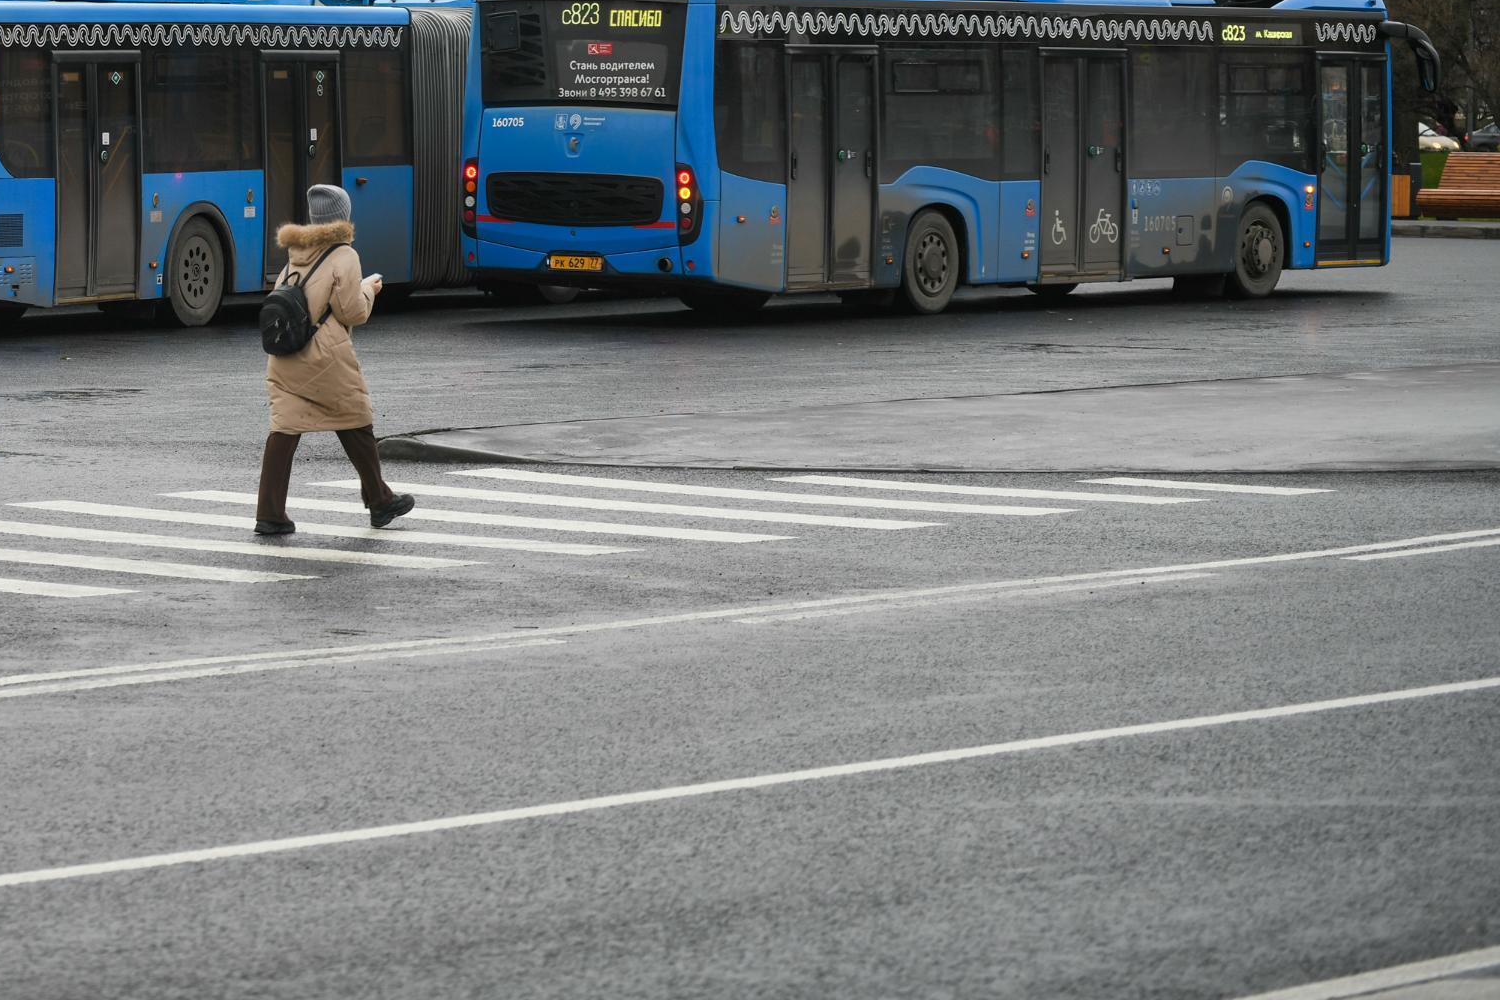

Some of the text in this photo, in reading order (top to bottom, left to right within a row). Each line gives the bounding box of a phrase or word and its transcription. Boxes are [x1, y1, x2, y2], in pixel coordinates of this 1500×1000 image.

[610, 10, 662, 27] СПАСИБО
[569, 61, 655, 71] Стань водителем
[574, 74, 650, 85] Мосгортранса!
[558, 88, 667, 98] Звони 8 495 398 67 61
[492, 117, 525, 128] 160705
[1144, 215, 1176, 232] 160705
[554, 260, 565, 268] РК
[568, 258, 585, 268] 629
